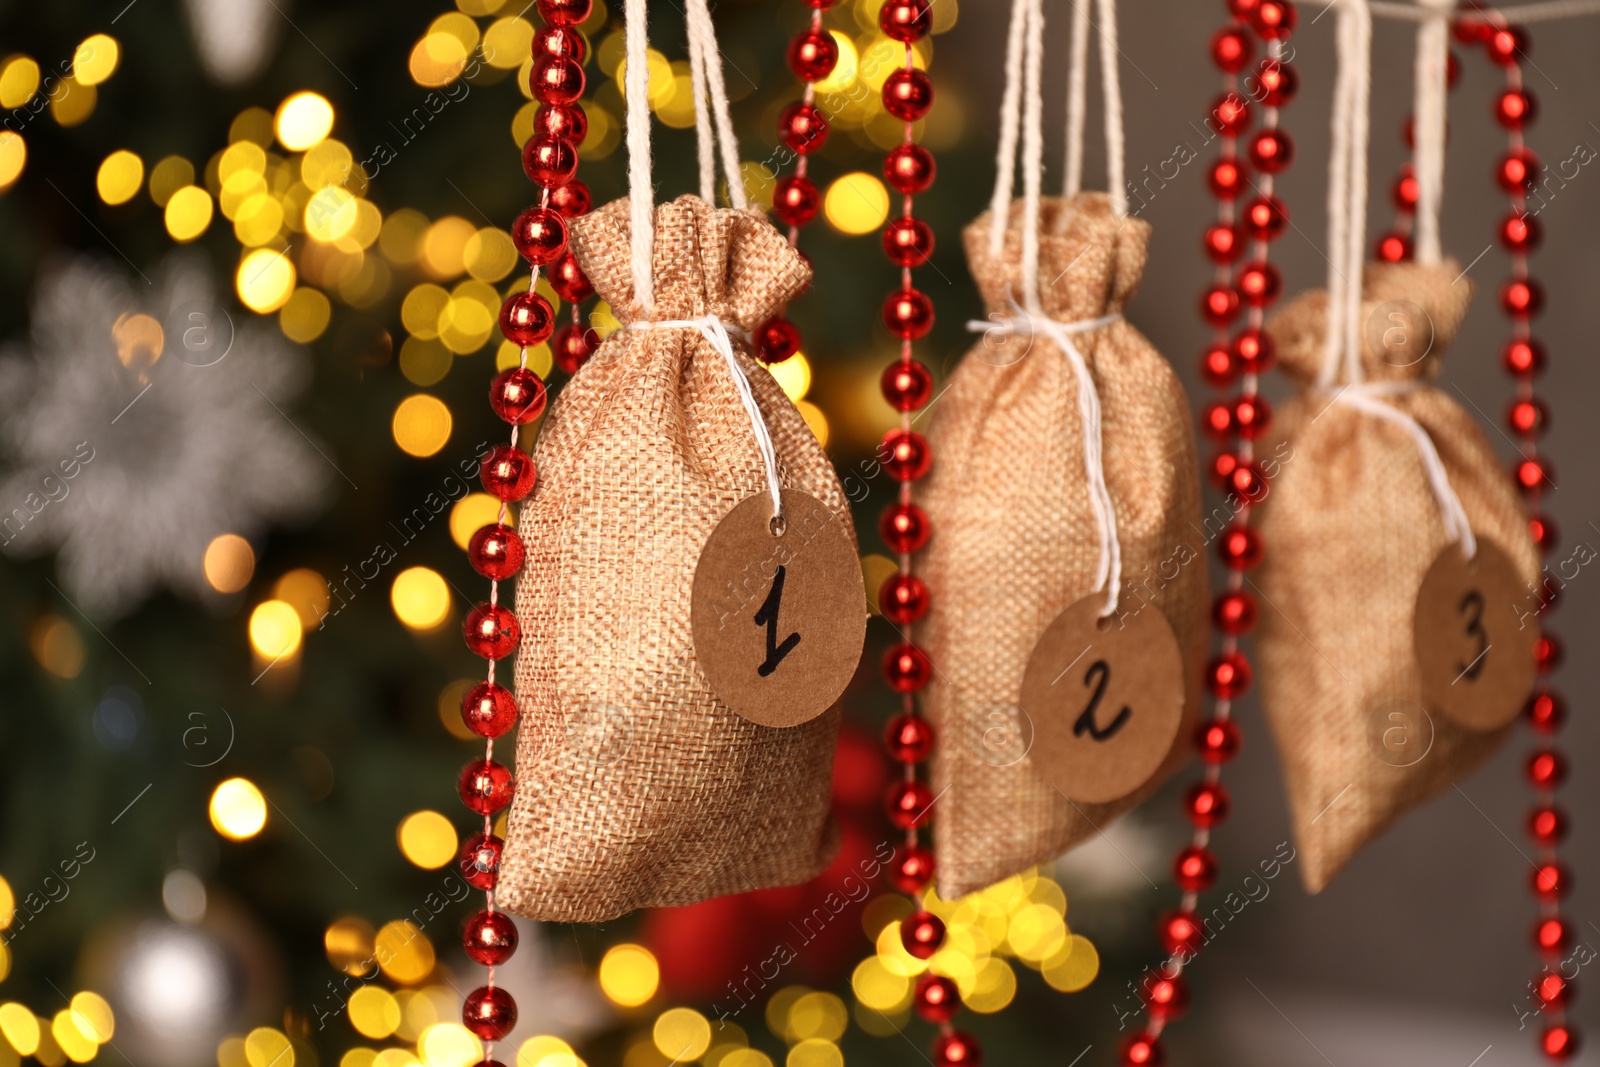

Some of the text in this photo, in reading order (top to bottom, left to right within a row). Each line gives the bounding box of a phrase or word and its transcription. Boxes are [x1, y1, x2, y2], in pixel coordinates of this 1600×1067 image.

[754, 565, 801, 677] 1
[1456, 589, 1487, 682] 3
[1073, 659, 1132, 742] 2
